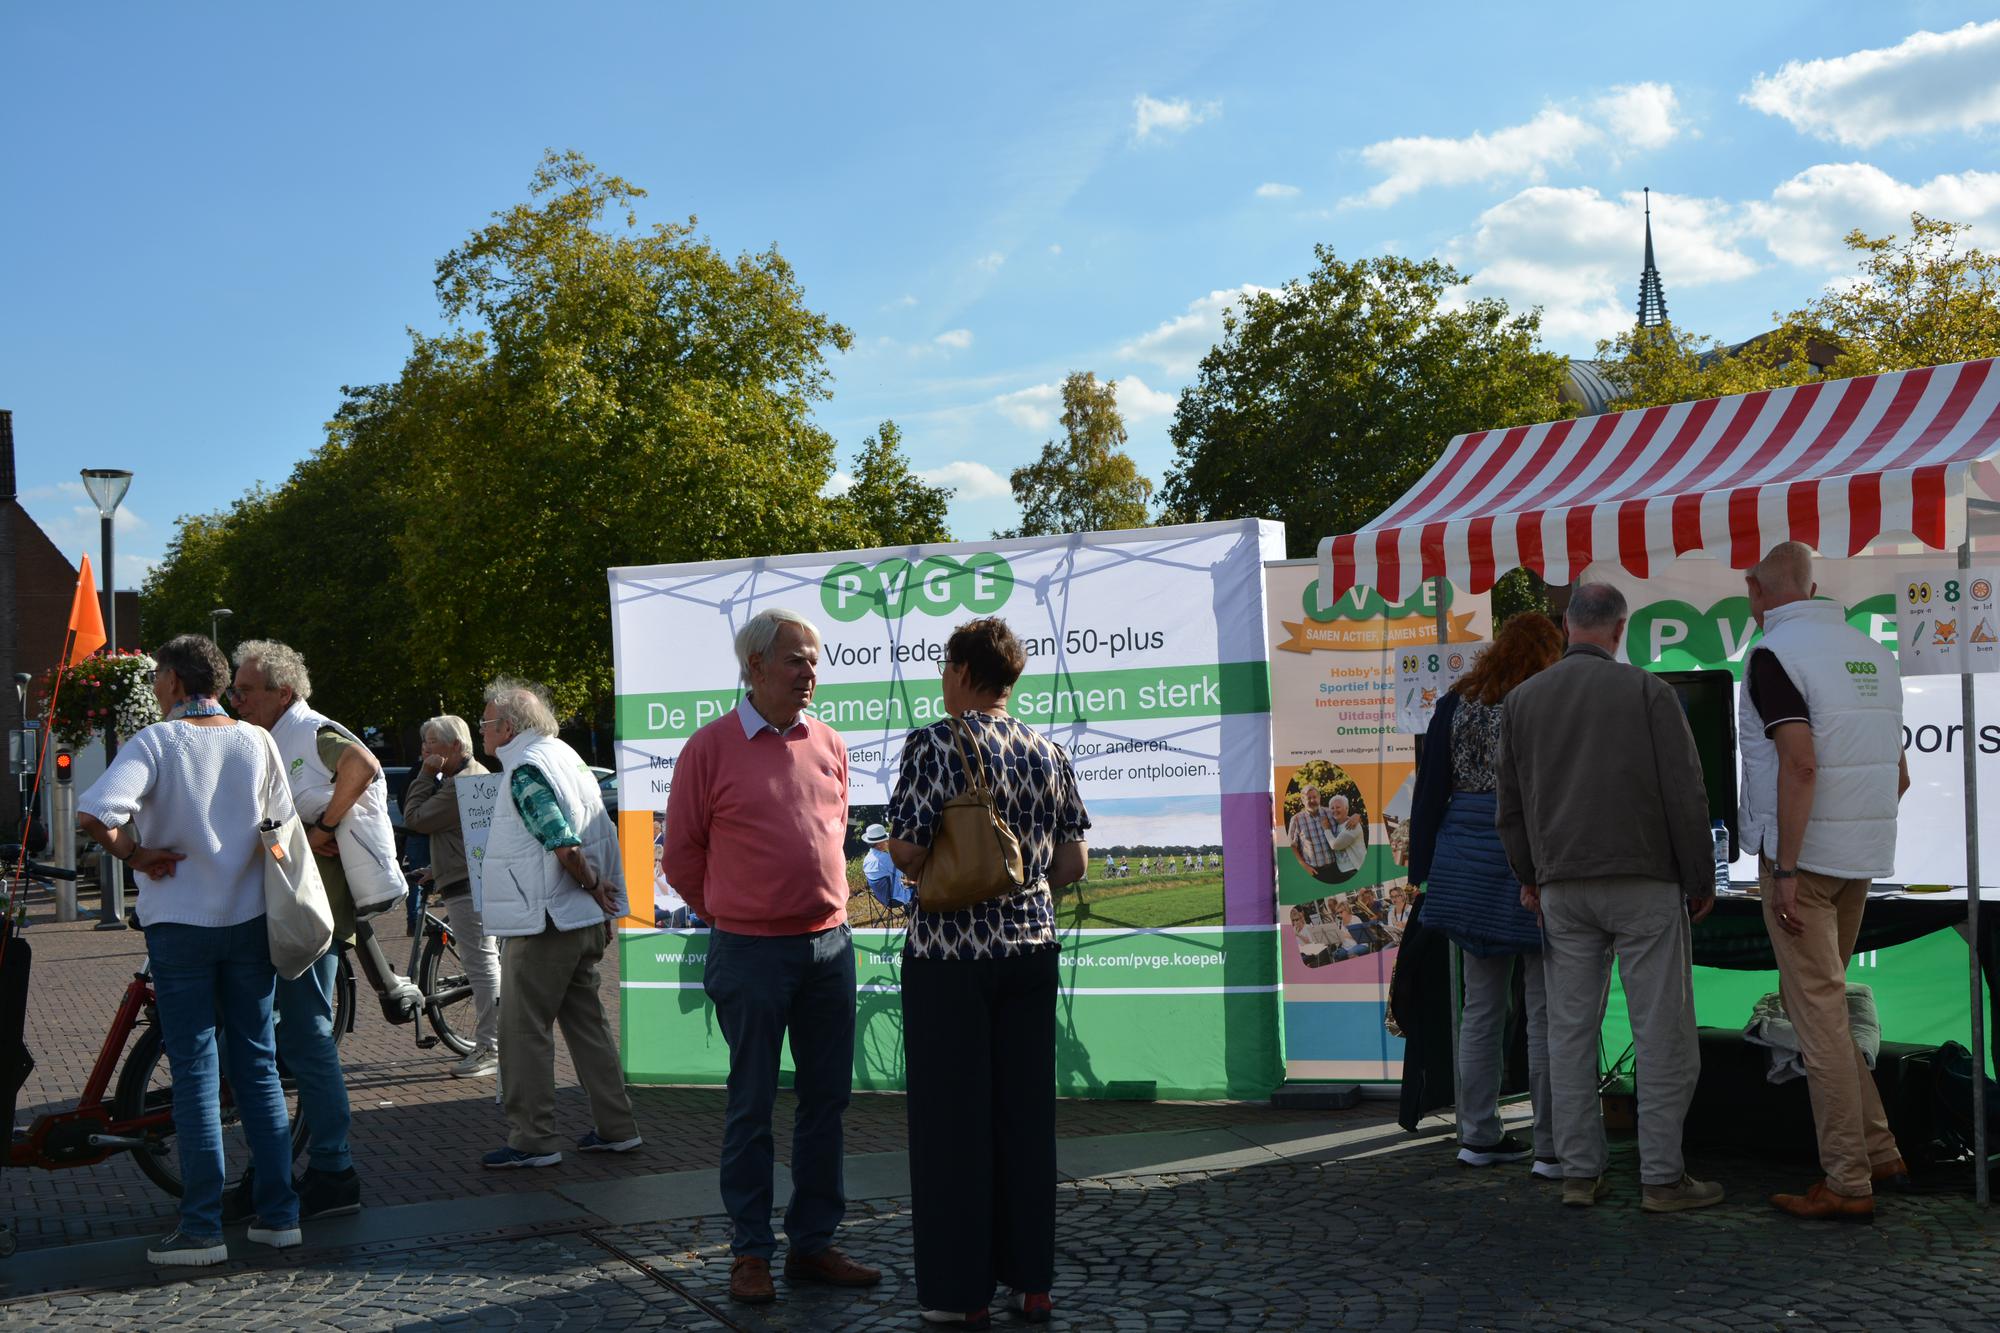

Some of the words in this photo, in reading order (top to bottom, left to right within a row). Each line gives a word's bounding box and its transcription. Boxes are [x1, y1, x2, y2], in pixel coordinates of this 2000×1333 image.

[838, 565, 995, 609] PVGE
[1317, 581, 1437, 612] VE
[1944, 580, 1960, 602] 8
[1306, 628, 1340, 641] SAMEN
[1381, 628, 1417, 641] SAMEN
[1650, 613, 1898, 663] PVE
[824, 642, 882, 667] Voor
[1025, 637, 1055, 656] an
[1066, 627, 1164, 658] 50-plus
[1331, 666, 1380, 678] Hobby's
[1428, 654, 1440, 673] 8
[1320, 681, 1369, 694] Sportief
[648, 703, 685, 730] De
[696, 698, 737, 728] PV
[1017, 686, 1125, 715] samen
[1139, 675, 1220, 709] sterk
[1315, 696, 1395, 707] Interessante
[1336, 725, 1397, 735] Ontmoete
[650, 756, 673, 769] Met
[1069, 743, 1101, 756] voor
[1106, 738, 1182, 754] anderen...
[1076, 766, 1123, 781] verder
[1128, 761, 1221, 782] ontplooien...
